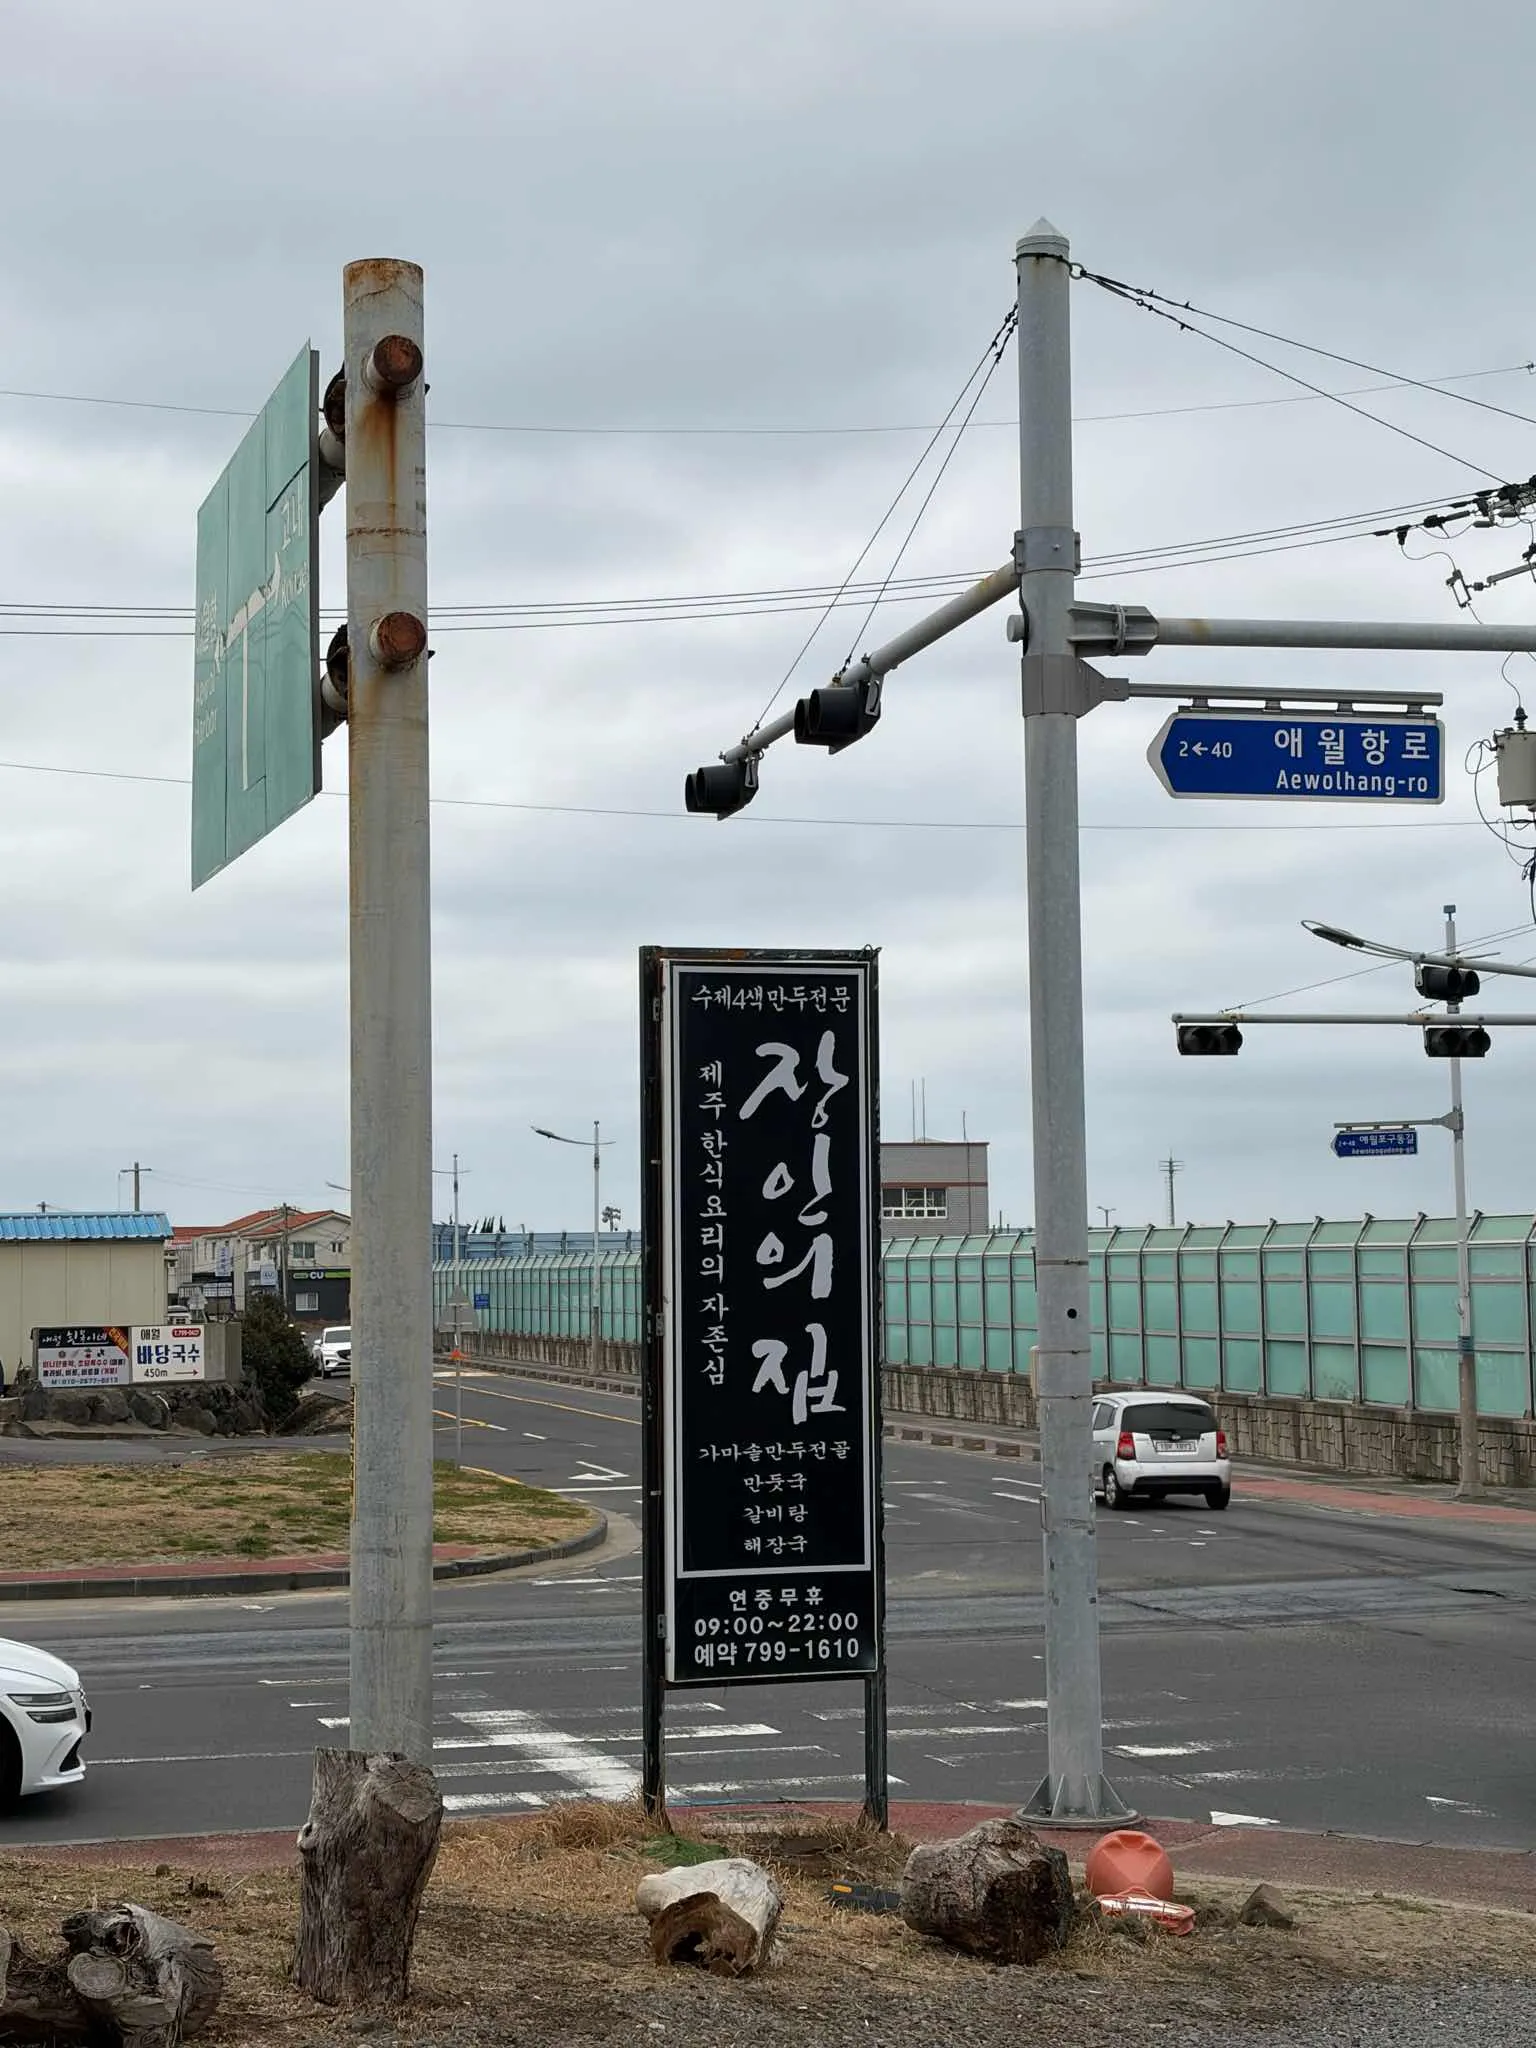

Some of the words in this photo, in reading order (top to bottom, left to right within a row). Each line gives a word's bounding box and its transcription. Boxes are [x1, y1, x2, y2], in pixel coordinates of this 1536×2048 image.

[1178, 740, 1189, 758] 2
[1210, 741, 1233, 758] 40
[1273, 726, 1431, 766] 애월항로
[1275, 769, 1429, 796] Aewolhang-ro
[309, 1272, 324, 1280] CU
[140, 1328, 161, 1341] 애월
[136, 1343, 201, 1365] 바당국수
[143, 1367, 168, 1378] 450m
[743, 1472, 808, 1493] 만둣국
[743, 1503, 809, 1525] 갈비탕
[743, 1535, 808, 1556] 해장국
[728, 1585, 825, 1612] 연중무휴
[694, 1611, 859, 1637] 09:00~22:00
[694, 1642, 738, 1668] 예약
[744, 1637, 860, 1663] 799-1610
